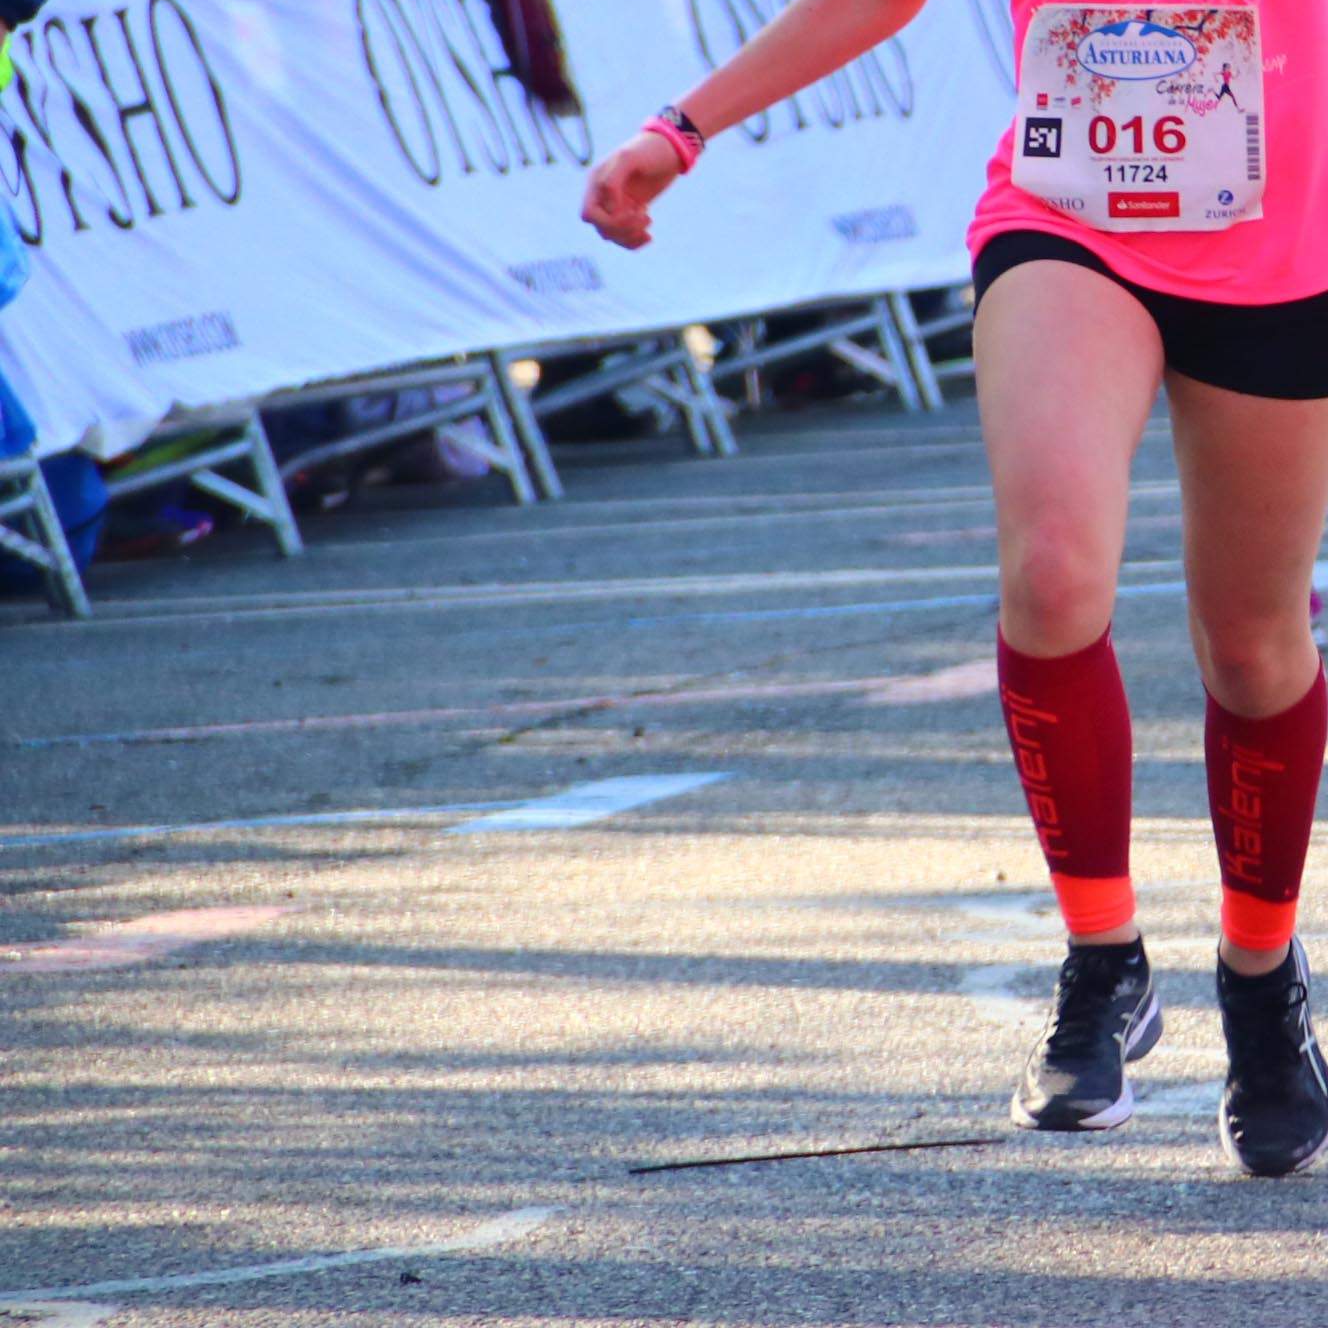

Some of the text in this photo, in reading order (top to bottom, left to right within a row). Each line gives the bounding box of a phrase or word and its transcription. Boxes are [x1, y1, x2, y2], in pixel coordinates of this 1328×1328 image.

[1085, 42, 1187, 65] ASTURIANA
[1089, 115, 1186, 154] 016
[1104, 165, 1168, 183] 11724
[1127, 199, 1171, 210] Santander
